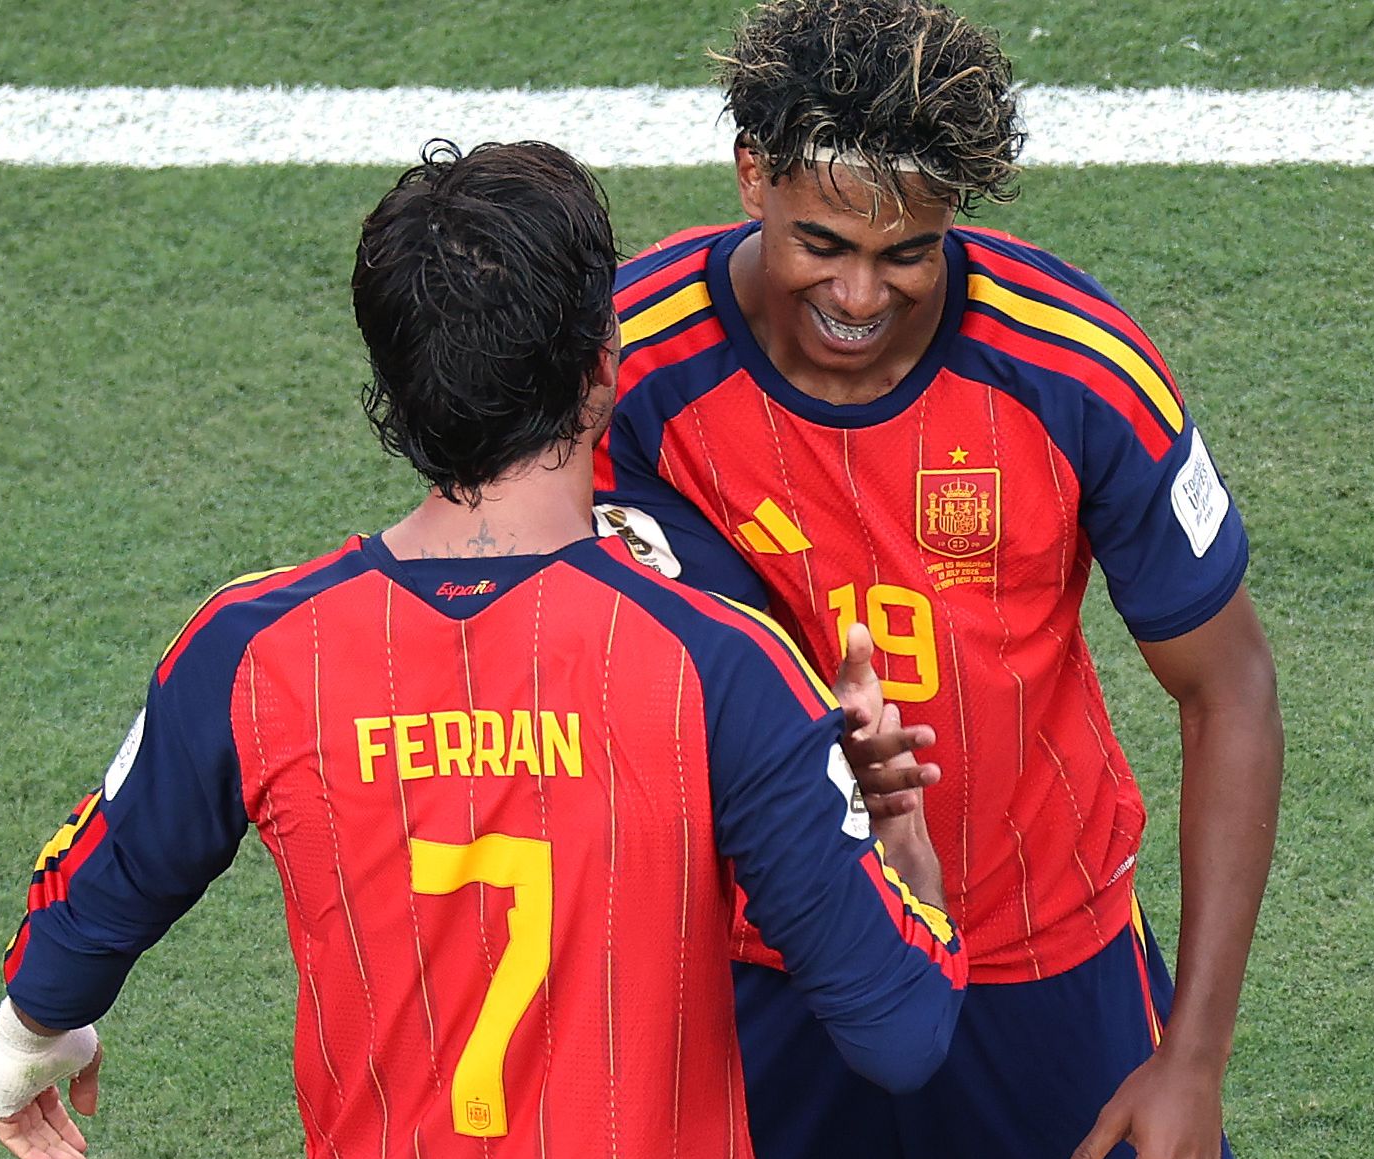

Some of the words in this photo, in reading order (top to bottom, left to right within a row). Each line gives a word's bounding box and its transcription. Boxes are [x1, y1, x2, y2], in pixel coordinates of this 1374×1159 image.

[828, 583, 940, 703] 19
[354, 710, 583, 782] FERRAN
[411, 833, 552, 1137] 7
